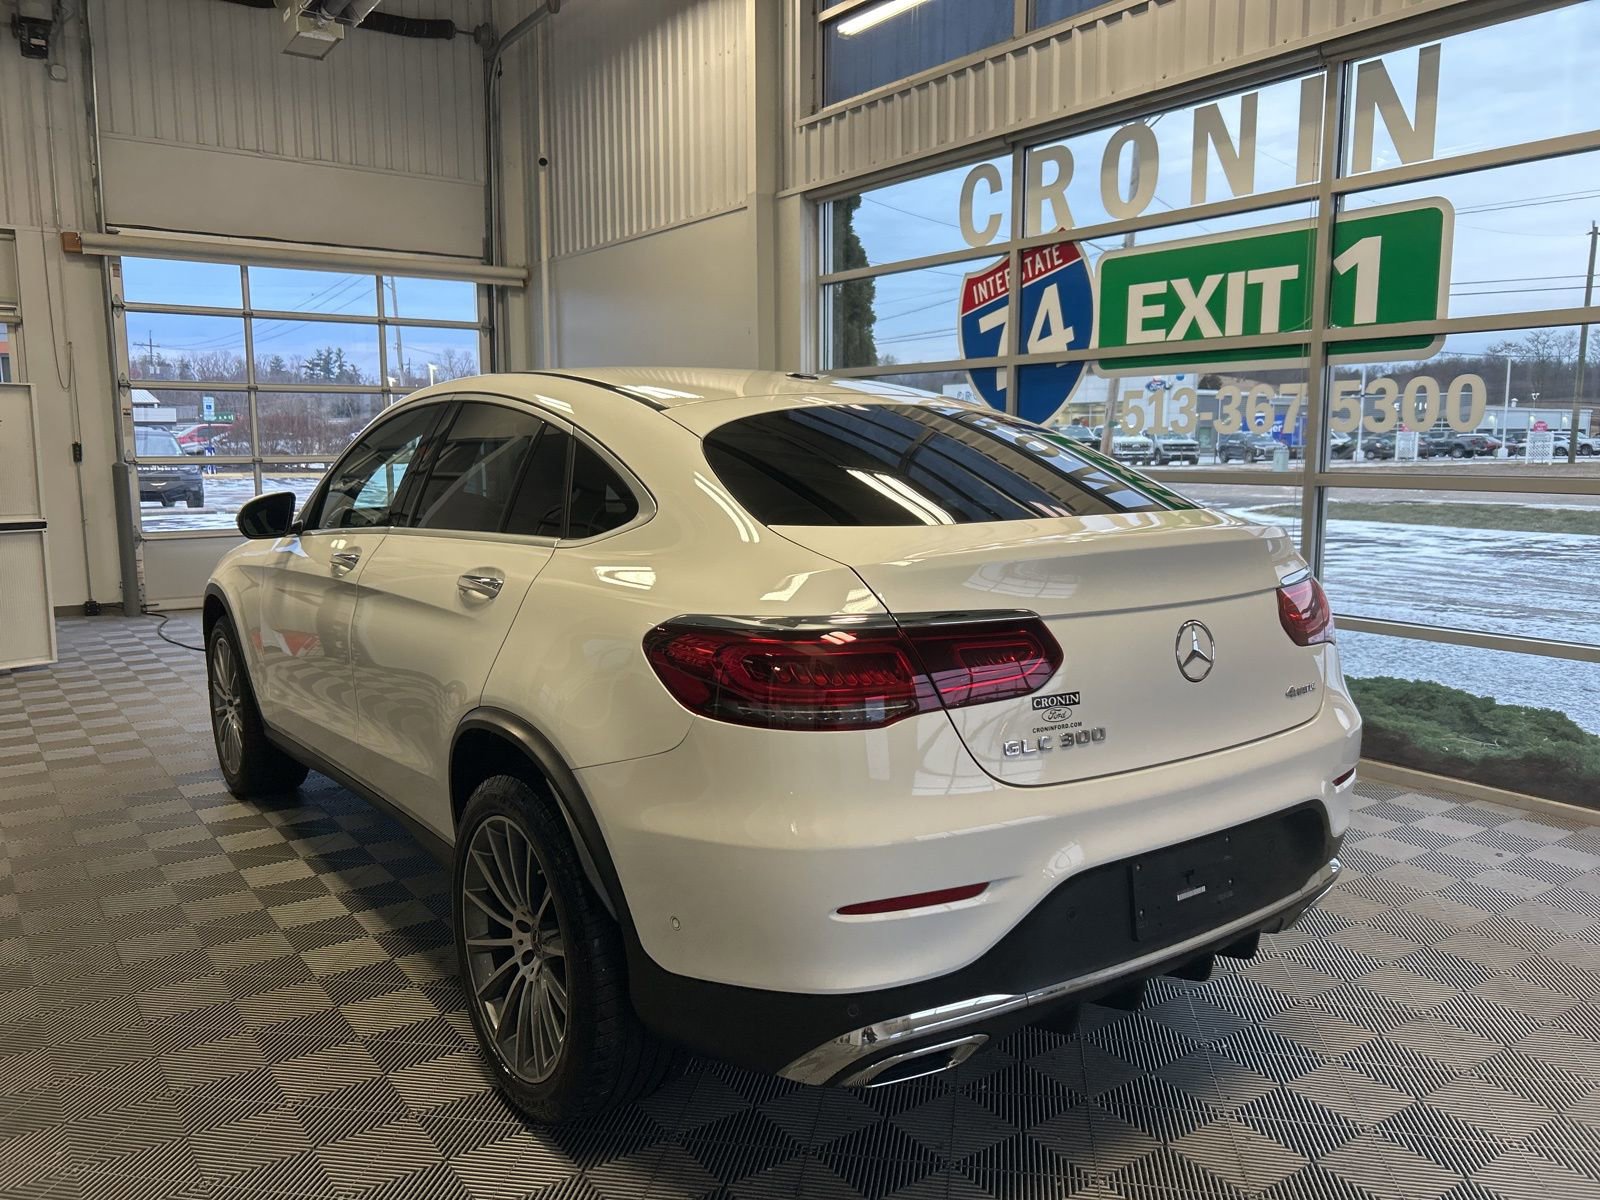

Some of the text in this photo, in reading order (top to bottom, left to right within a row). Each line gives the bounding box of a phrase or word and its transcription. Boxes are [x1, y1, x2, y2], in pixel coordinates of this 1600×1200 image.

[959, 43, 1442, 249] CRONIN
[972, 246, 1063, 304] INTERTATE
[1126, 235, 1382, 344] EXIT 1
[978, 283, 1075, 391] 74
[1033, 693, 1079, 708] CRONIN
[1048, 708, 1066, 721] Ford
[1003, 727, 1106, 756] GLC 300
[1032, 722, 1082, 733] CRONINFORD.COM
